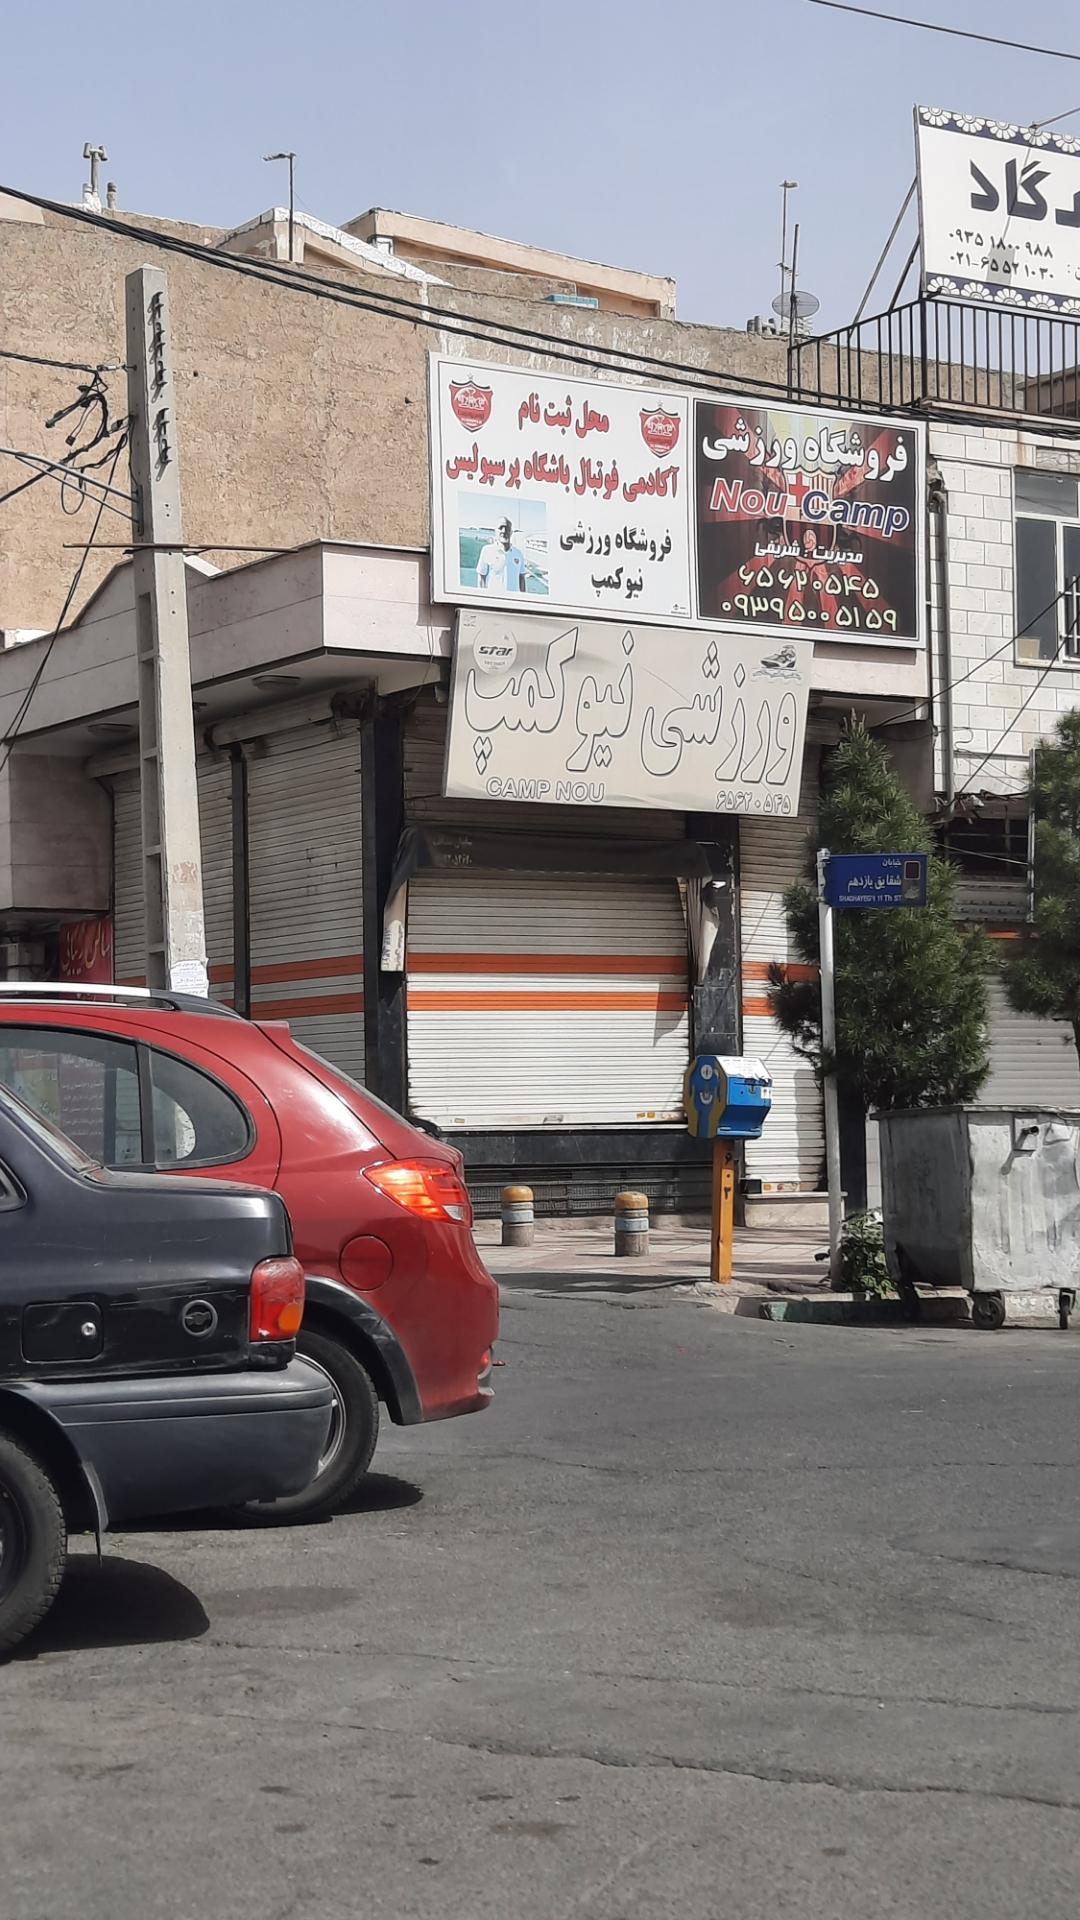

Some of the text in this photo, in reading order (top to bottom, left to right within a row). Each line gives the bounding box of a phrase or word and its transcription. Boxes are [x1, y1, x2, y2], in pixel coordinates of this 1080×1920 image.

[518, 392, 540, 430] نام
[543, 394, 572, 435] ثبت
[576, 400, 610, 438] محل
[702, 418, 909, 482] فروشگاه ورزشی
[446, 442, 680, 503] آکادمی فوتبال باشگاه پرسپولیس
[710, 477, 911, 538] Nou Camp
[560, 520, 673, 562] فروشگاه ورزشی
[754, 541, 801, 559] شریفی
[812, 544, 864, 564] مدیریت
[640, 640, 797, 785] ورزشی
[485, 776, 605, 802] CAMP NOU
[881, 858, 902, 867] خیابان
[847, 874, 902, 893] شقایق یازدهم
